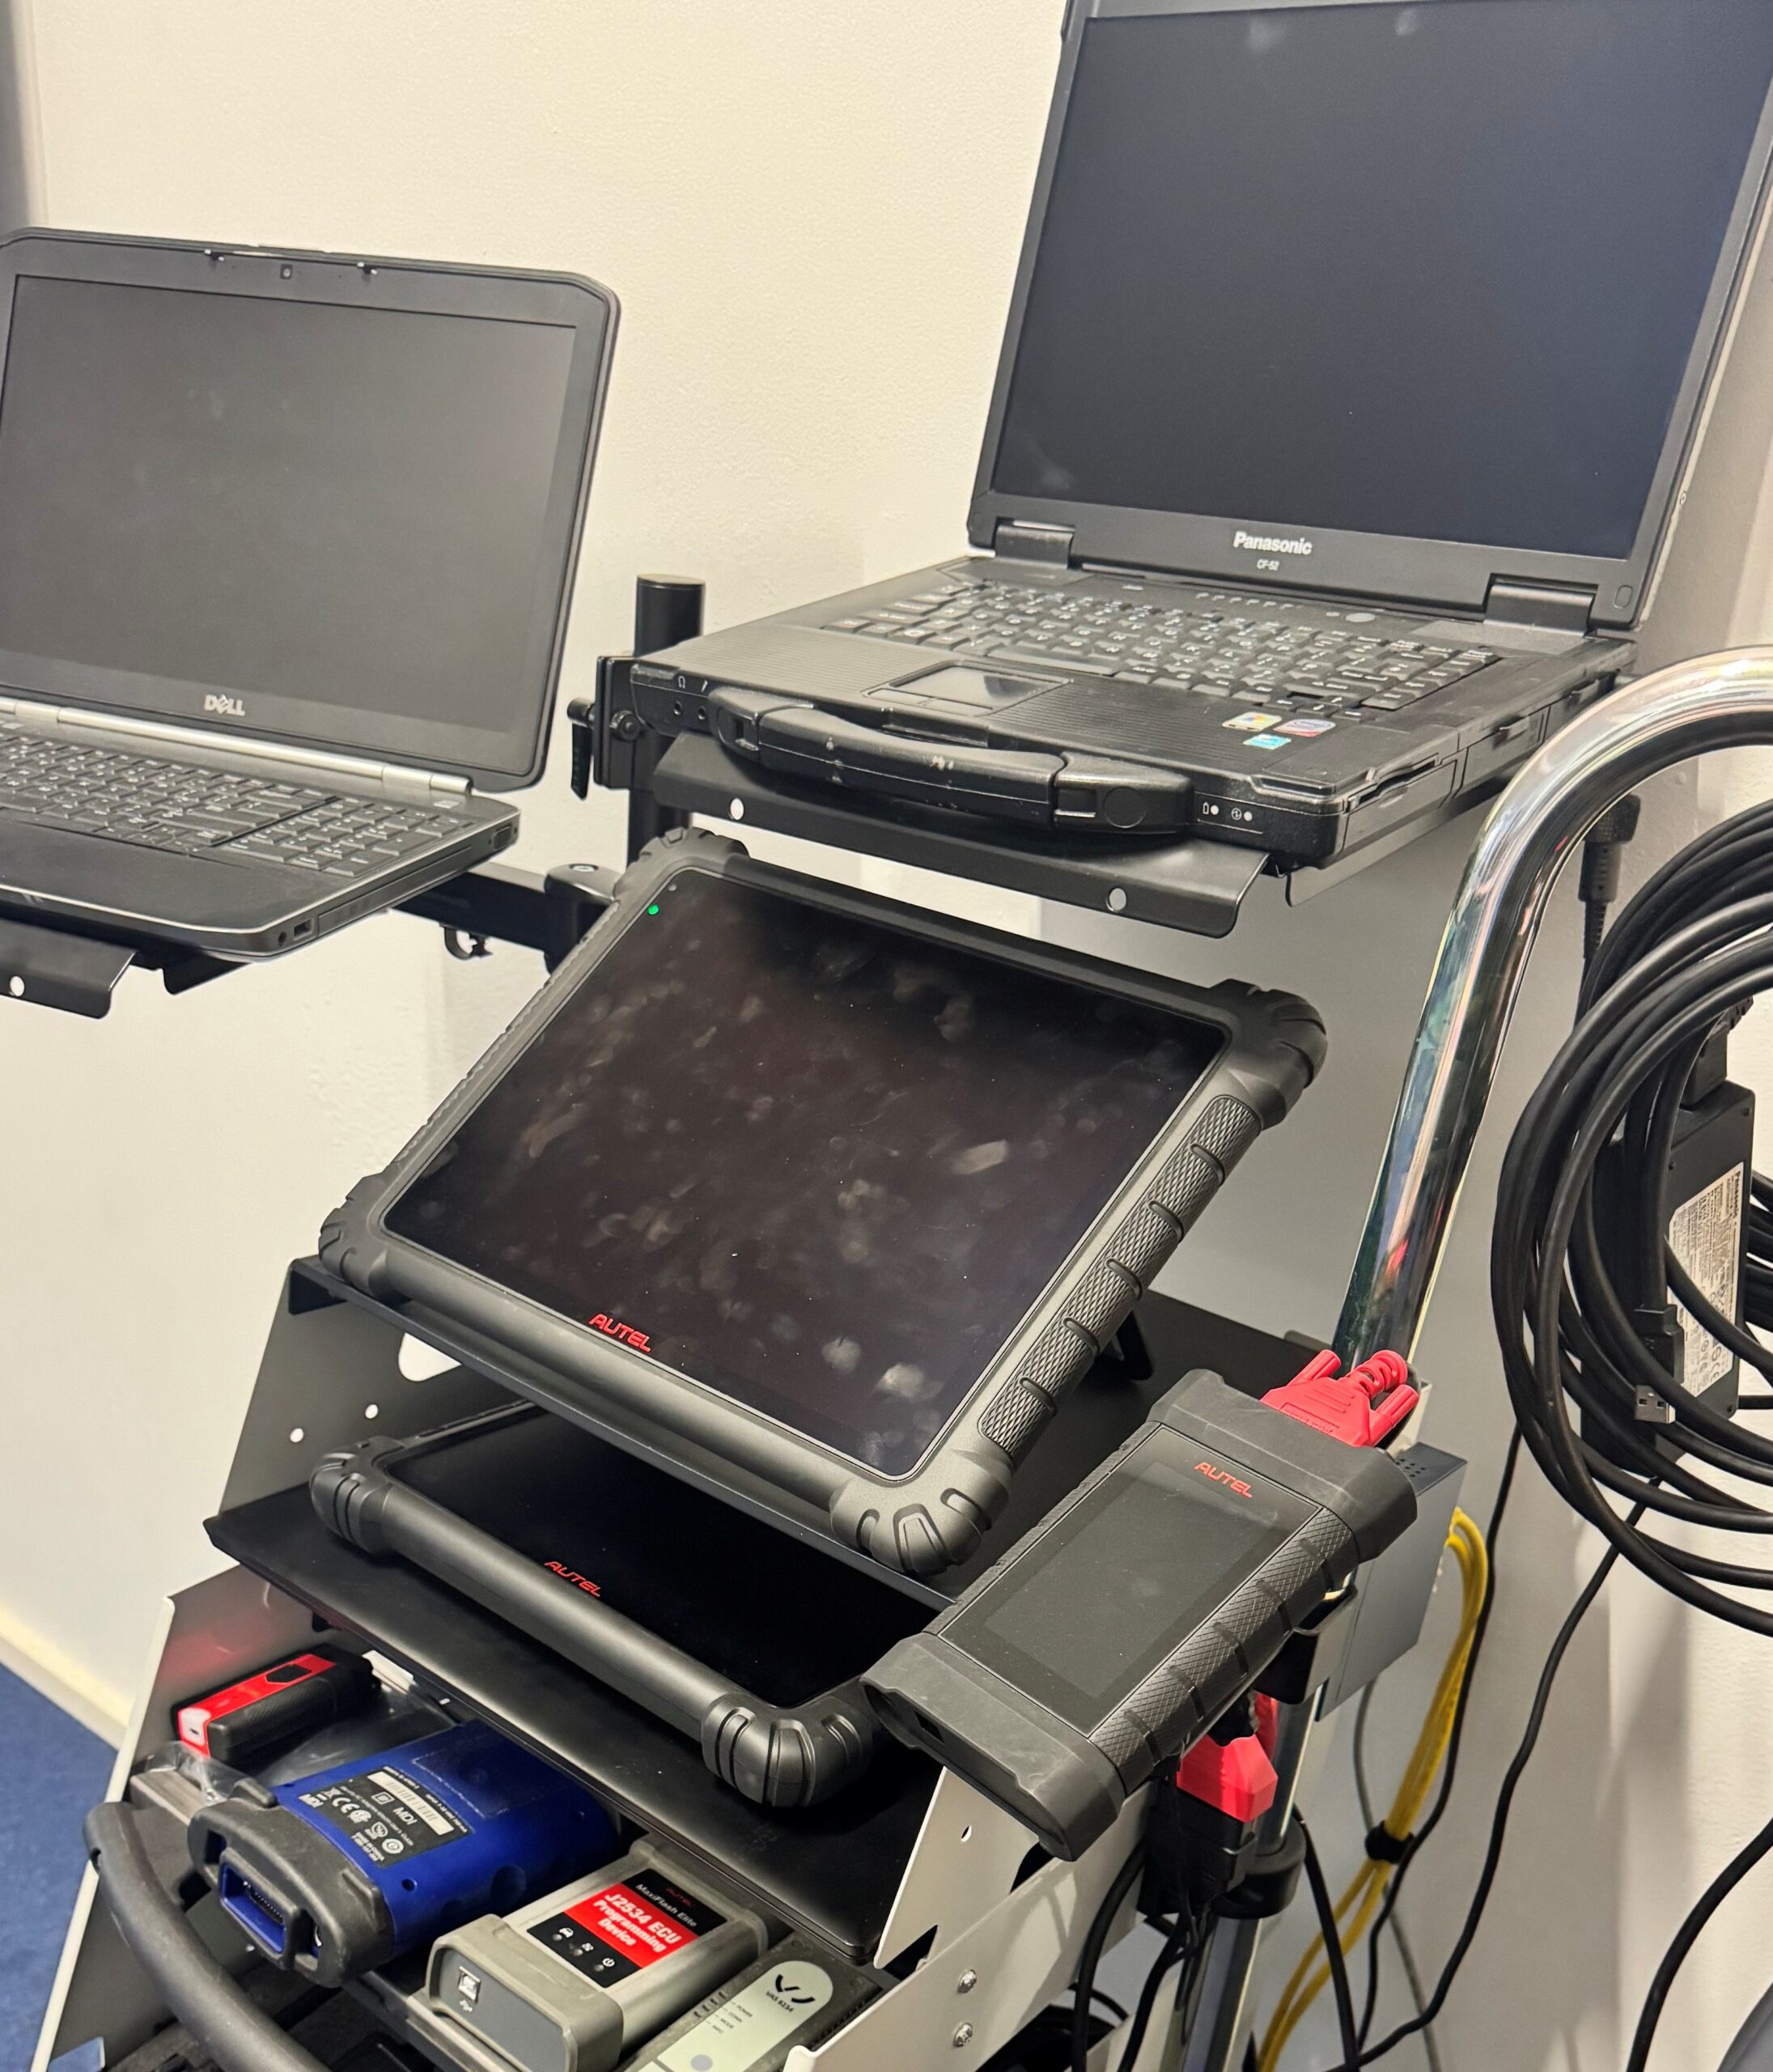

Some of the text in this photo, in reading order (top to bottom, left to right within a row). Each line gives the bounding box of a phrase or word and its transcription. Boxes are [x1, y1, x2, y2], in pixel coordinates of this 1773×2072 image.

[1232, 531, 1313, 555] Panasonic
[204, 694, 246, 717] DELL
[588, 1313, 651, 1352] AUTEL
[1194, 1462, 1253, 1499] AUTEL
[543, 1560, 601, 1597] AUTEL
[392, 1807, 418, 1825] MDI
[604, 1893, 683, 1944] J2534 ECU
[635, 1883, 698, 1927] MaxiFlash Elite
[592, 1899, 668, 1953] Programming
[597, 1917, 638, 1947] Device
